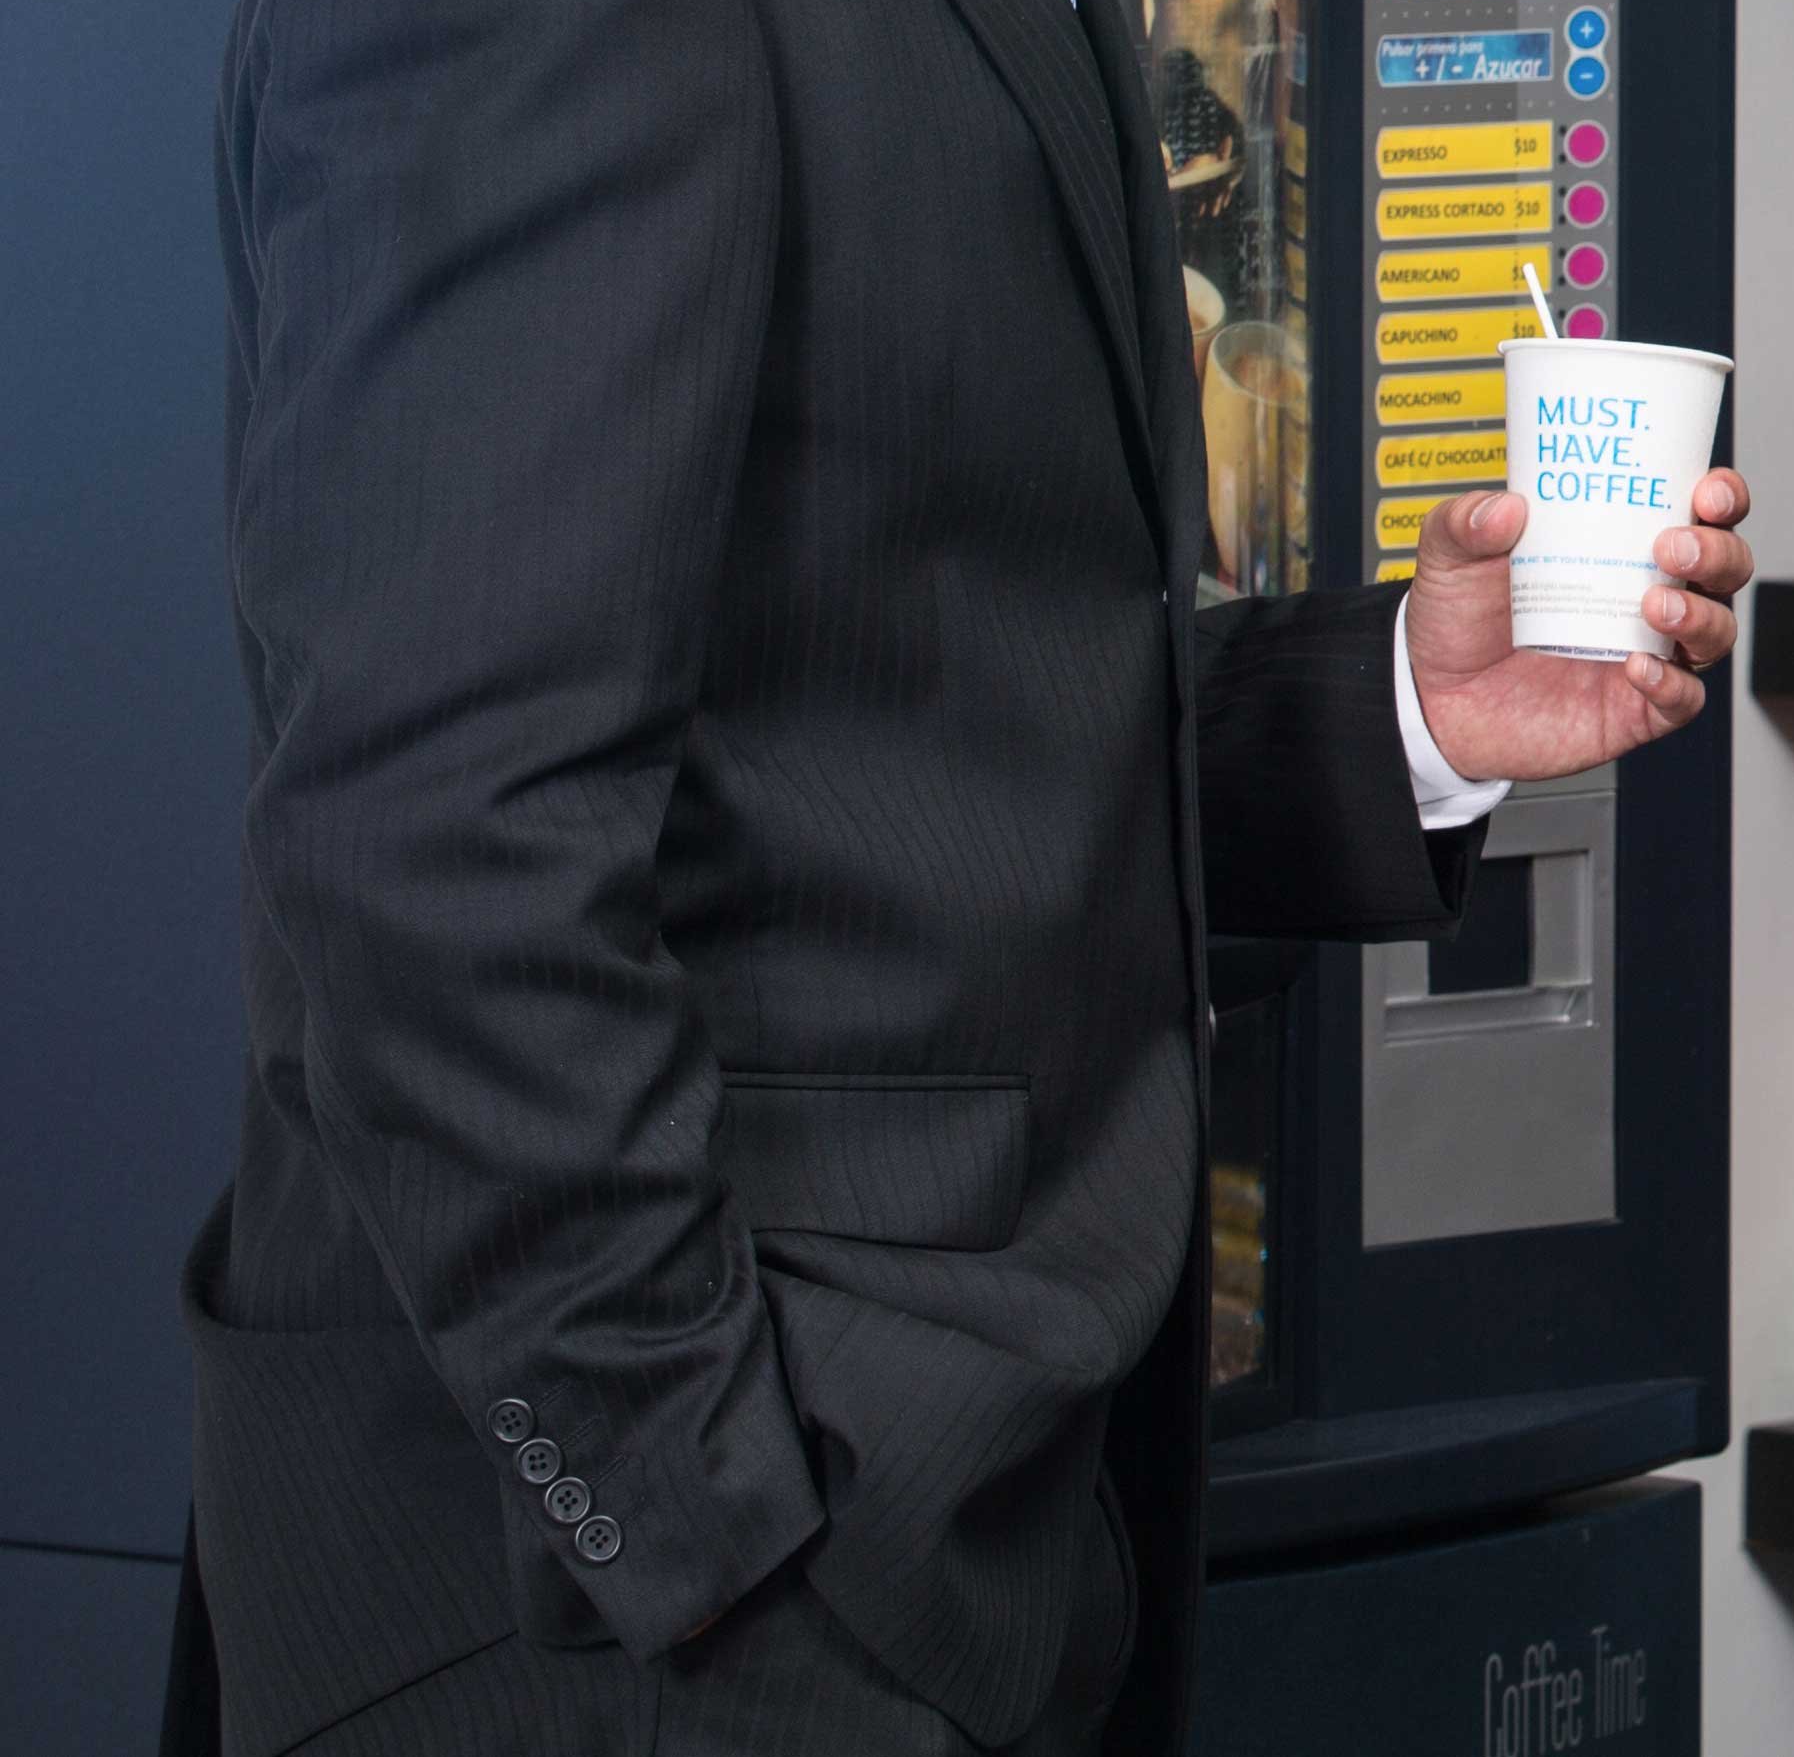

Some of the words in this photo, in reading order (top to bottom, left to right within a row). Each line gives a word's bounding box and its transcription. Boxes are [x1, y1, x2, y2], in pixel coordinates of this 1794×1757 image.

[1472, 54, 1543, 80] Azucar
[1383, 145, 1448, 163] EXPRESSO
[1514, 139, 1537, 154] $10
[1386, 204, 1440, 219] EXPRESS
[1443, 202, 1505, 218] CORTADO
[1516, 201, 1540, 216] $10
[1380, 267, 1460, 283] AMERICANO
[1381, 328, 1458, 345] CAPUCHINO
[1380, 390, 1463, 407] MOCACHINO
[1537, 395, 1650, 431] MUST.
[1384, 451, 1416, 469] CAFÉ
[1537, 434, 1641, 467] HAVE.
[1536, 471, 1672, 510] COFFEE.
[1485, 1640, 1583, 1757] Coffee
[1592, 1623, 1647, 1739] Time
